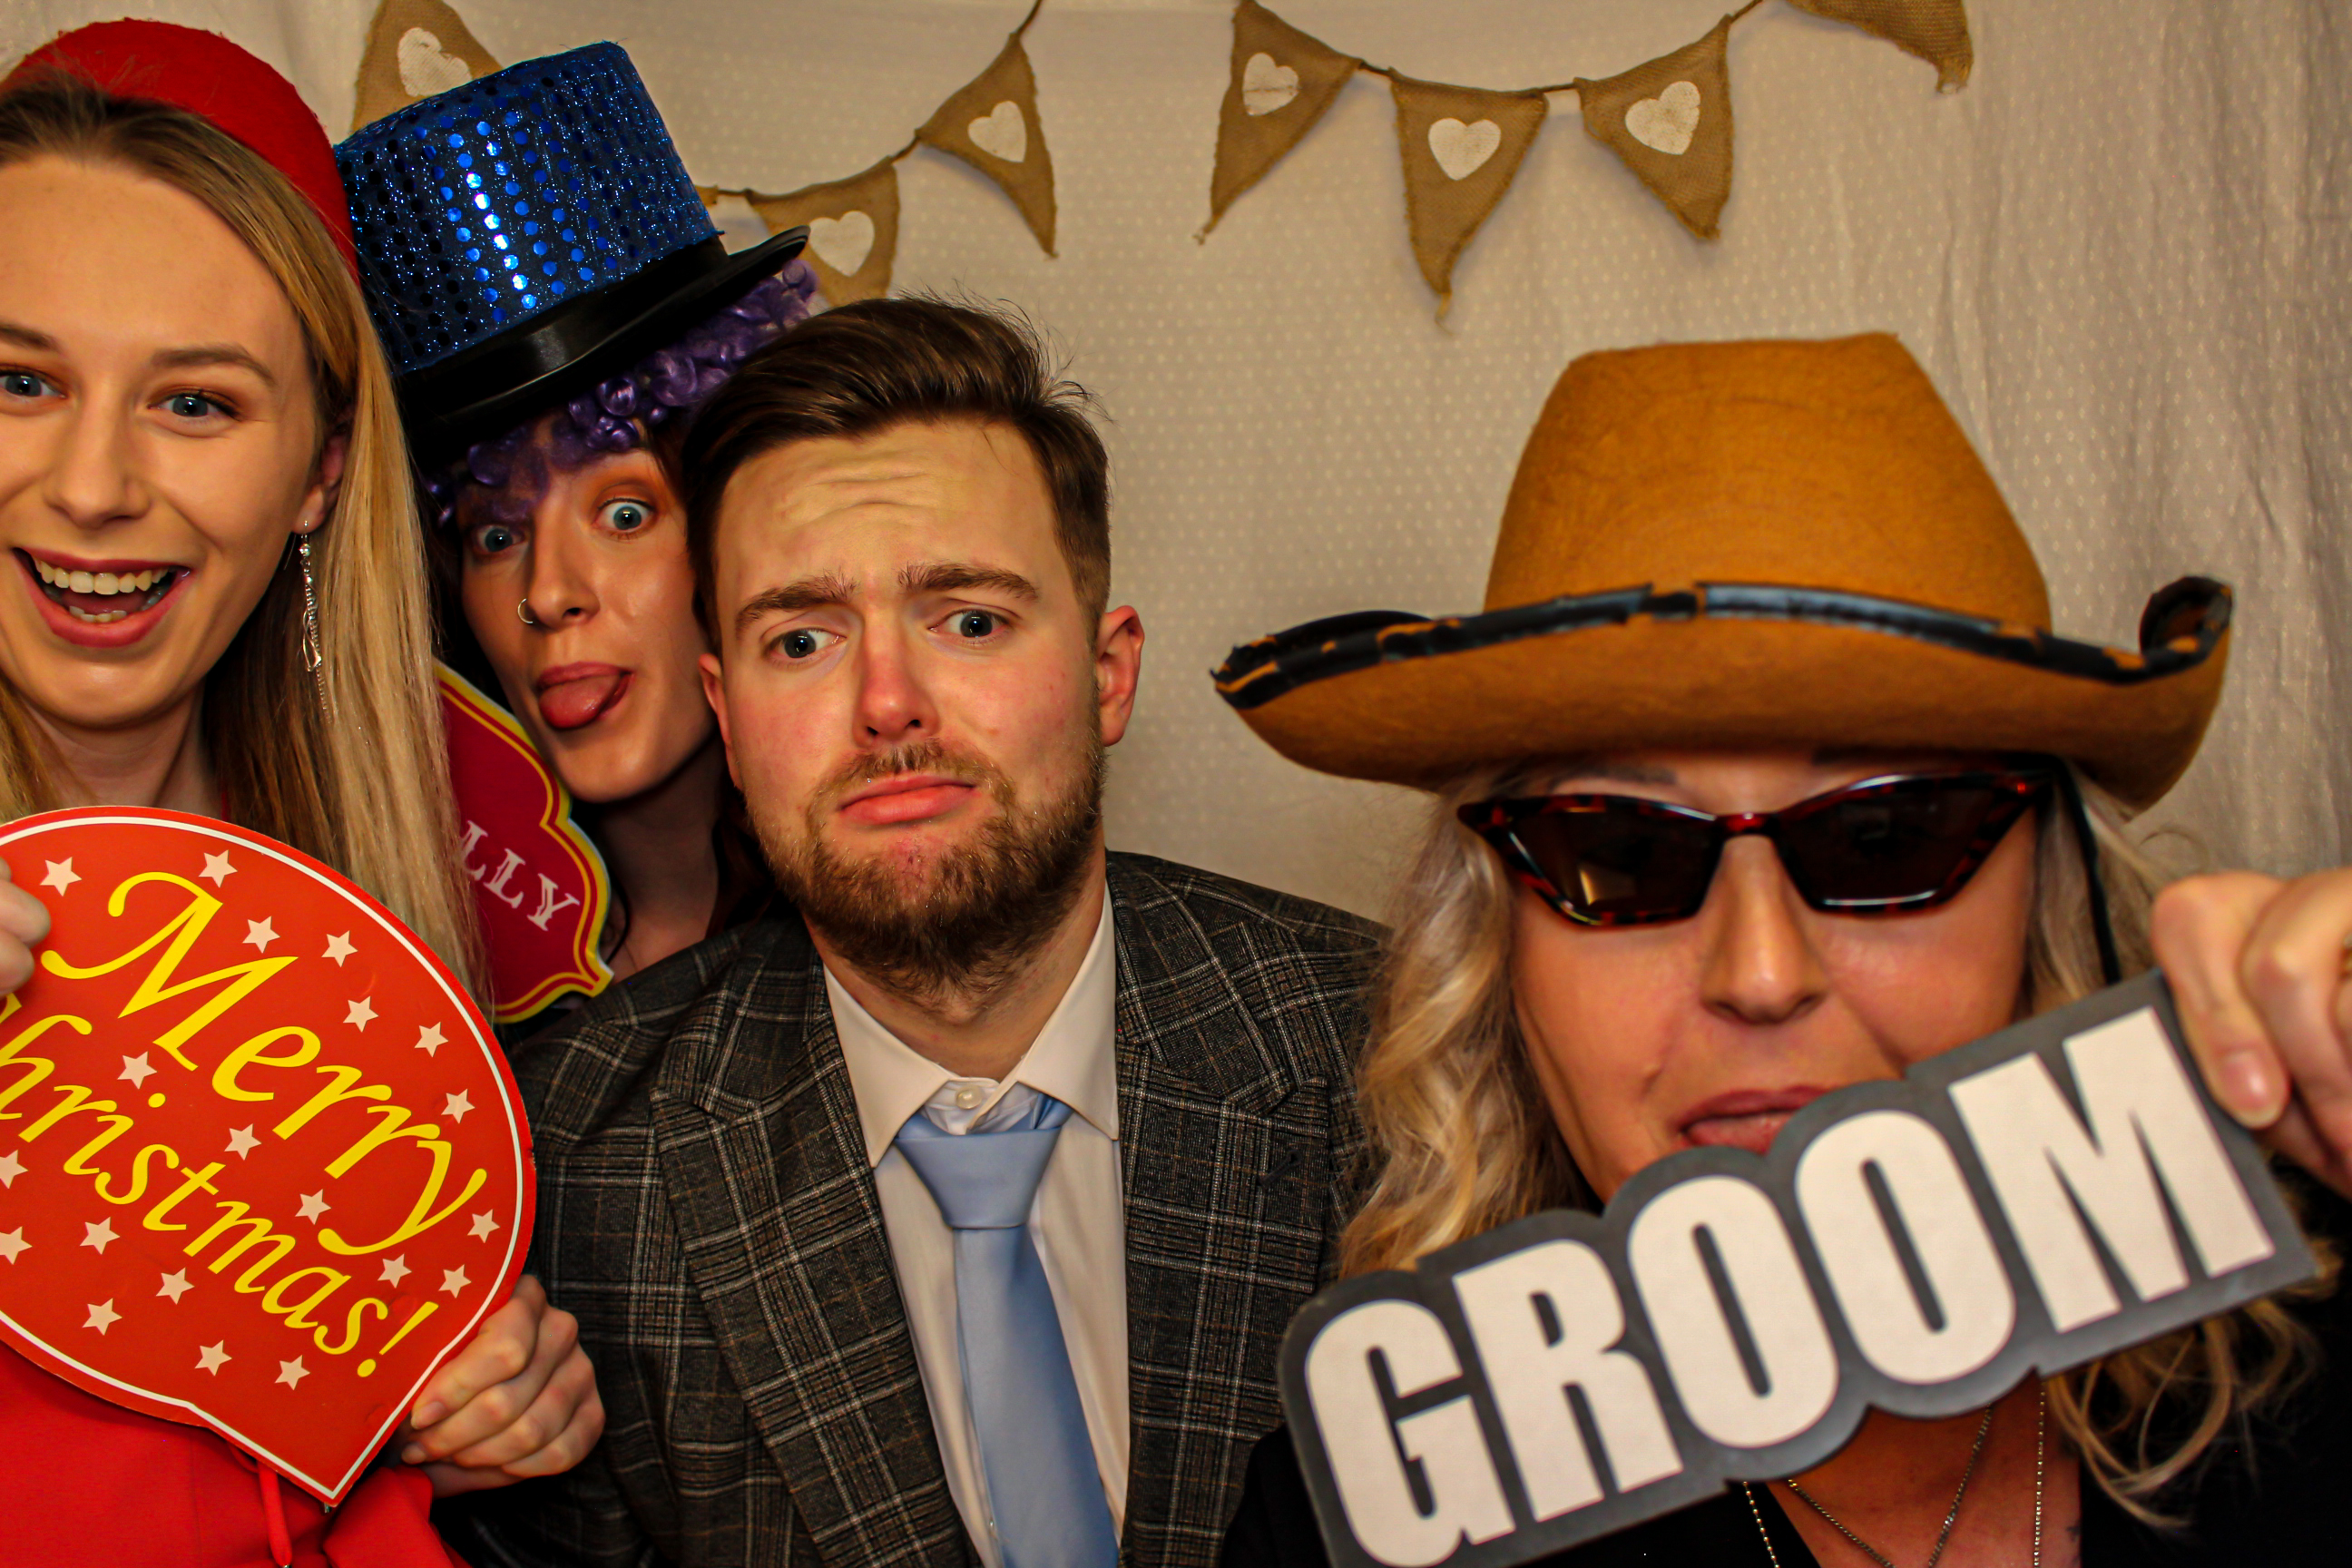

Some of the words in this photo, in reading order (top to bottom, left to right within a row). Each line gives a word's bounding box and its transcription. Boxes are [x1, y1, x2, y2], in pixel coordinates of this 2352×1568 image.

[41, 871, 487, 1256] Merry
[456, 820, 581, 932] LLY
[0, 993, 438, 1377] hristmas!
[1304, 1005, 2274, 1567] GROOM
